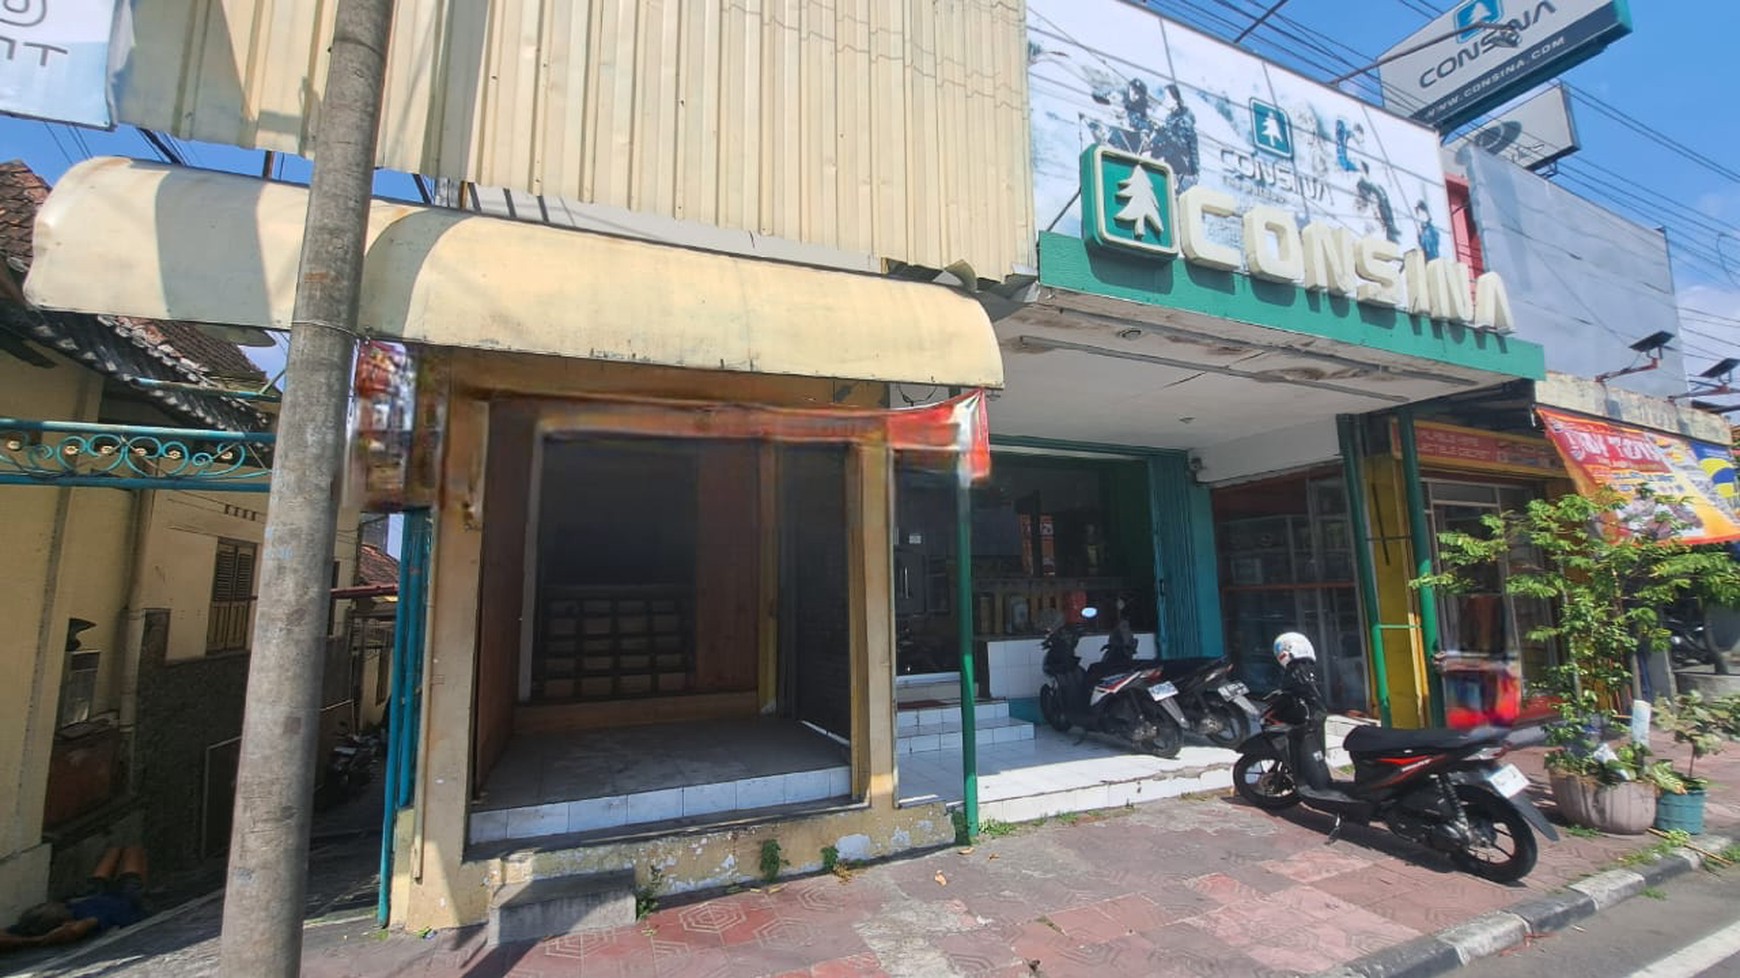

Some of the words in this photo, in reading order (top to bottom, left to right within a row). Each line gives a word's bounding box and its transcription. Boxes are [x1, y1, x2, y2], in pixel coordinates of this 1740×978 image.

[1419, 0, 1557, 89] CONSNA
[1220, 148, 1335, 207] CONSINA
[1179, 185, 1516, 335] CONSINA
